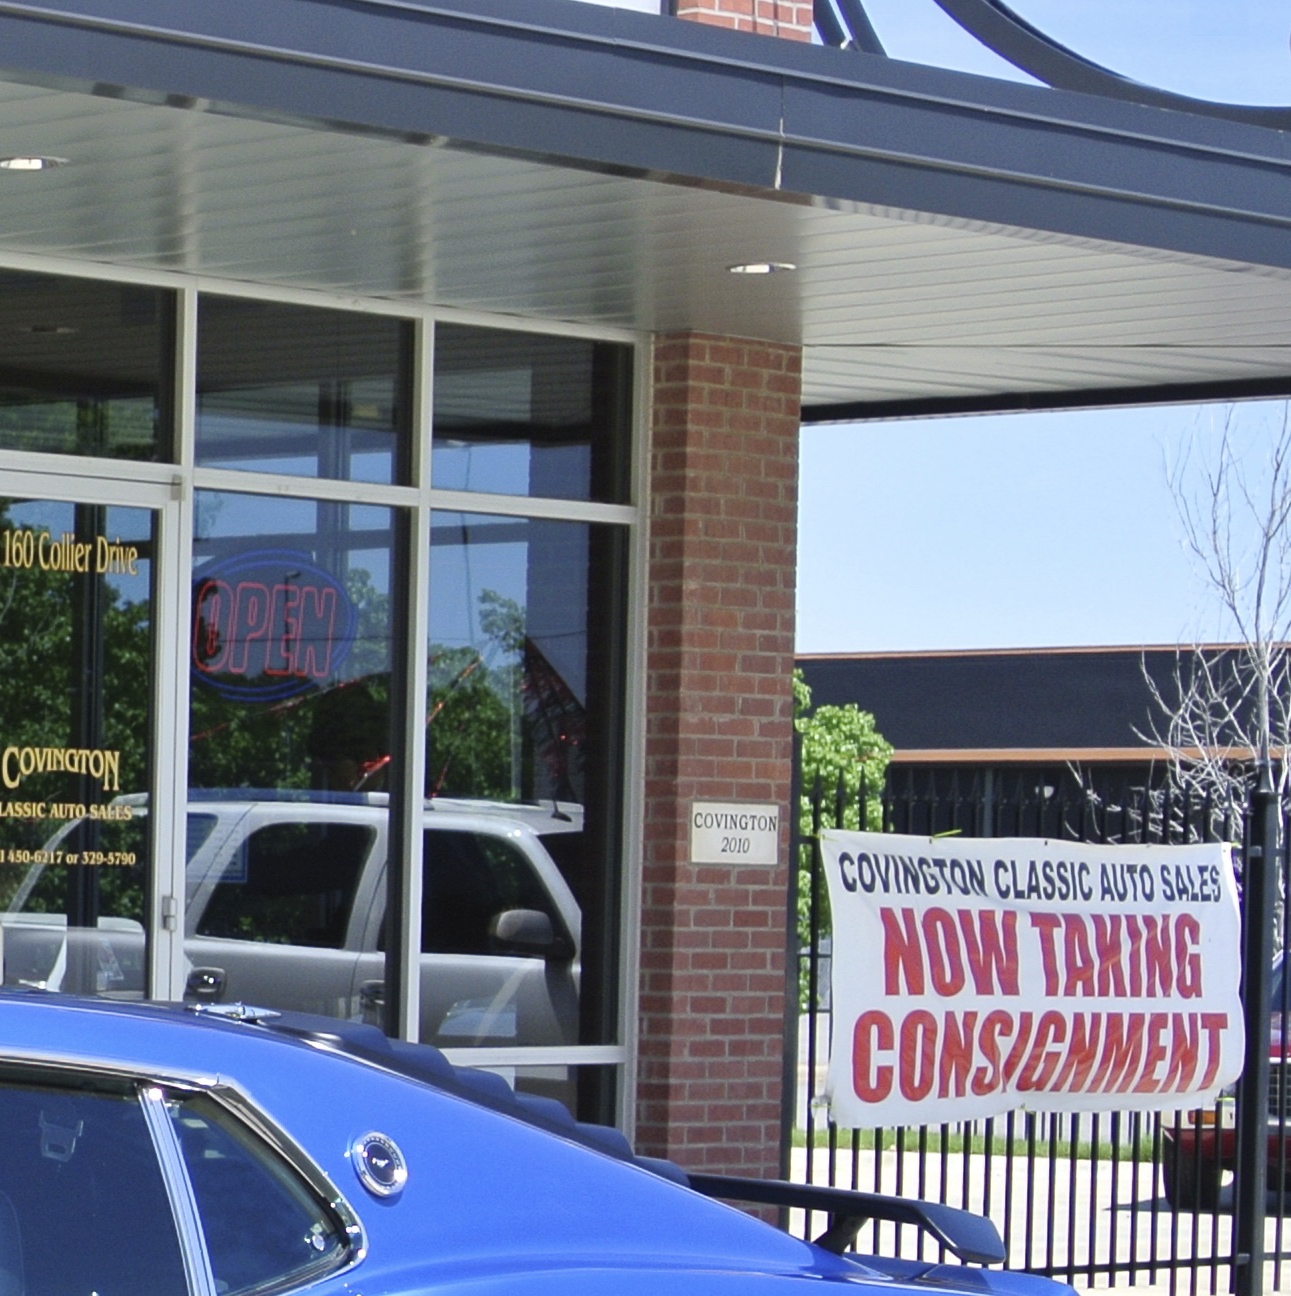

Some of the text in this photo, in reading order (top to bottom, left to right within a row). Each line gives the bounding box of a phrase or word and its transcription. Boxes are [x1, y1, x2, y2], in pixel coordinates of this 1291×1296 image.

[38, 531, 92, 573] Collier
[96, 535, 138, 576] Drive
[193, 579, 337, 678] OPEN
[1, 746, 121, 791] COVINGTON
[49, 803, 87, 820] AUTO
[89, 803, 133, 821] SALES
[693, 812, 778, 832] COVINGTON
[7, 849, 63, 865] 450-6217
[66, 853, 79, 865] or
[82, 851, 137, 866] 329-5790
[721, 836, 751, 854] 2010
[838, 851, 1222, 903] COVINGTON CLASSIC AUTO SALES
[879, 906, 1203, 1000] NOW TAKING
[852, 1008, 1229, 1105] CONSIGNMENT
